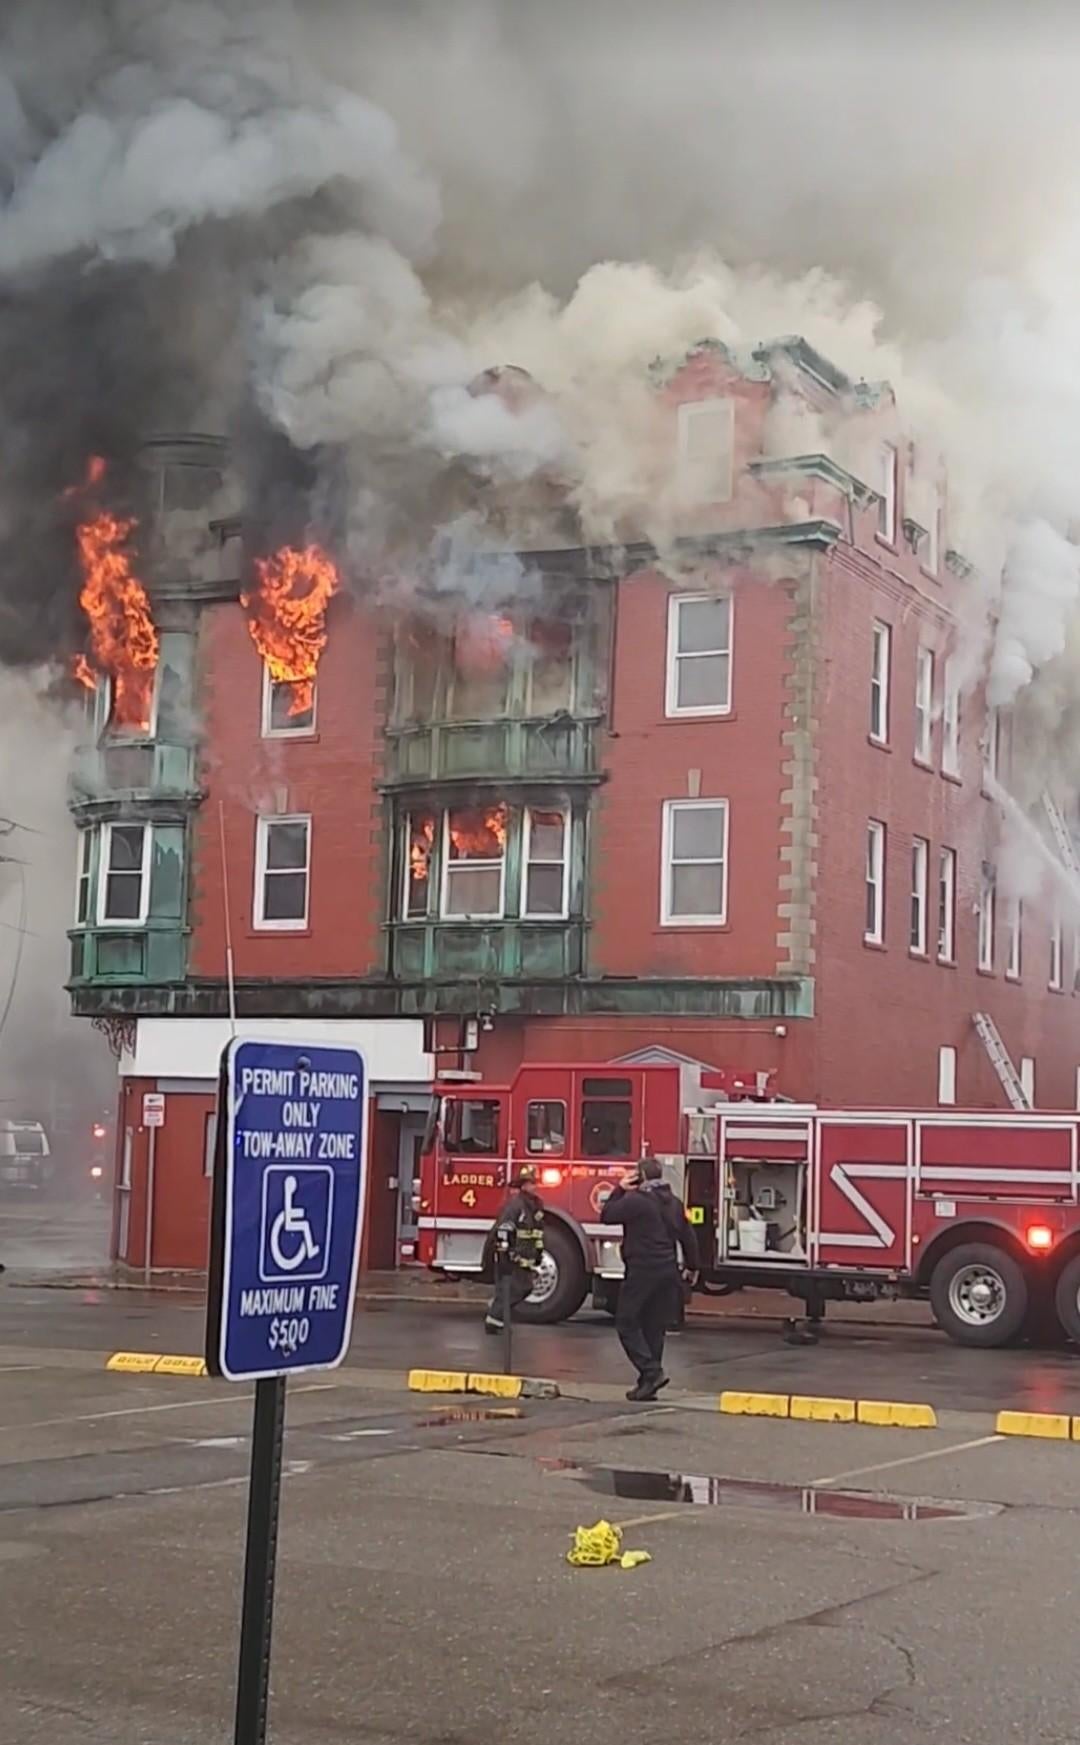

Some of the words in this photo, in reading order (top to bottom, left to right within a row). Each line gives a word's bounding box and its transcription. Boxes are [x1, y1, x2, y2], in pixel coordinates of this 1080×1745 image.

[242, 1068, 295, 1096] PERMIT
[300, 1071, 358, 1099] PARKING
[282, 1101, 321, 1127] ONLY
[242, 1131, 314, 1157] TOW-AWAY
[318, 1132, 355, 1159] ZONE
[443, 1174, 494, 1186] LADDER
[461, 1189, 477, 1207] 4
[240, 1288, 305, 1317] MAXIMUM
[308, 1284, 339, 1311] FINE
[268, 1317, 309, 1350] $500
